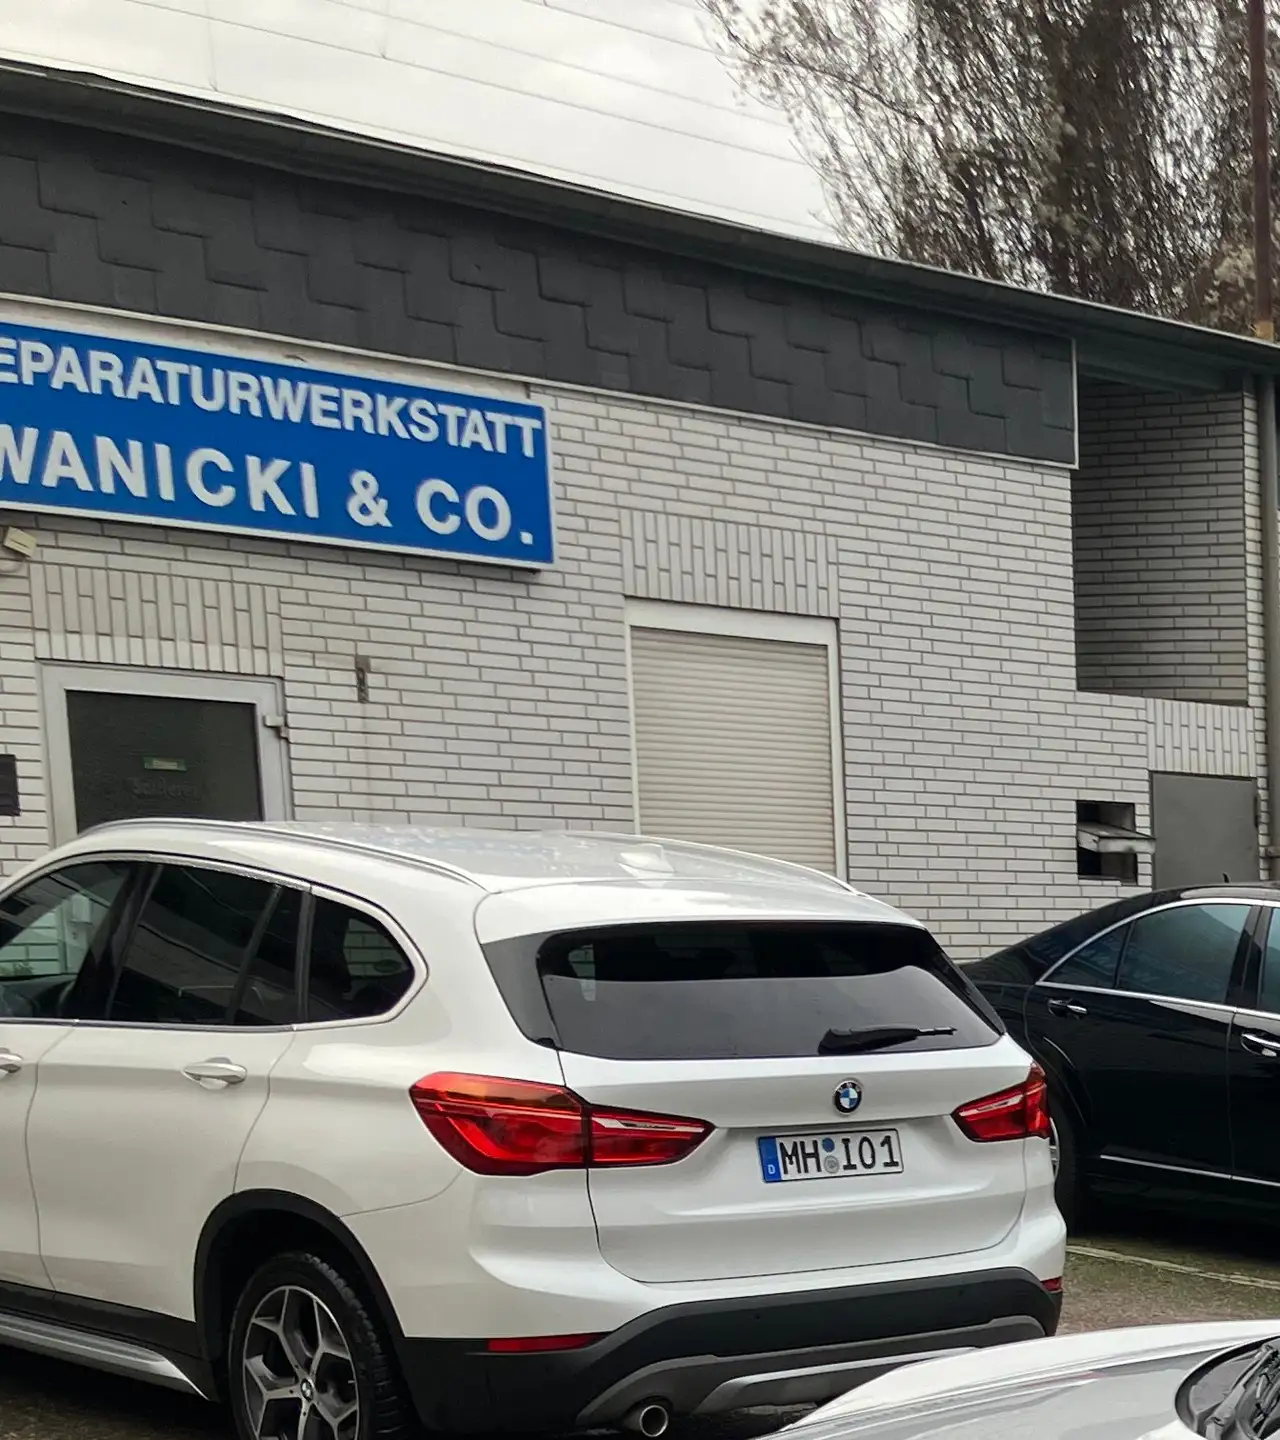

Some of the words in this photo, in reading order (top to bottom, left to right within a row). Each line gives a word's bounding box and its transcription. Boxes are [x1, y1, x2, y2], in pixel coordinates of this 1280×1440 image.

[346, 470, 392, 528] &
[416, 479, 534, 545] CO.
[778, 1139, 823, 1175] MH
